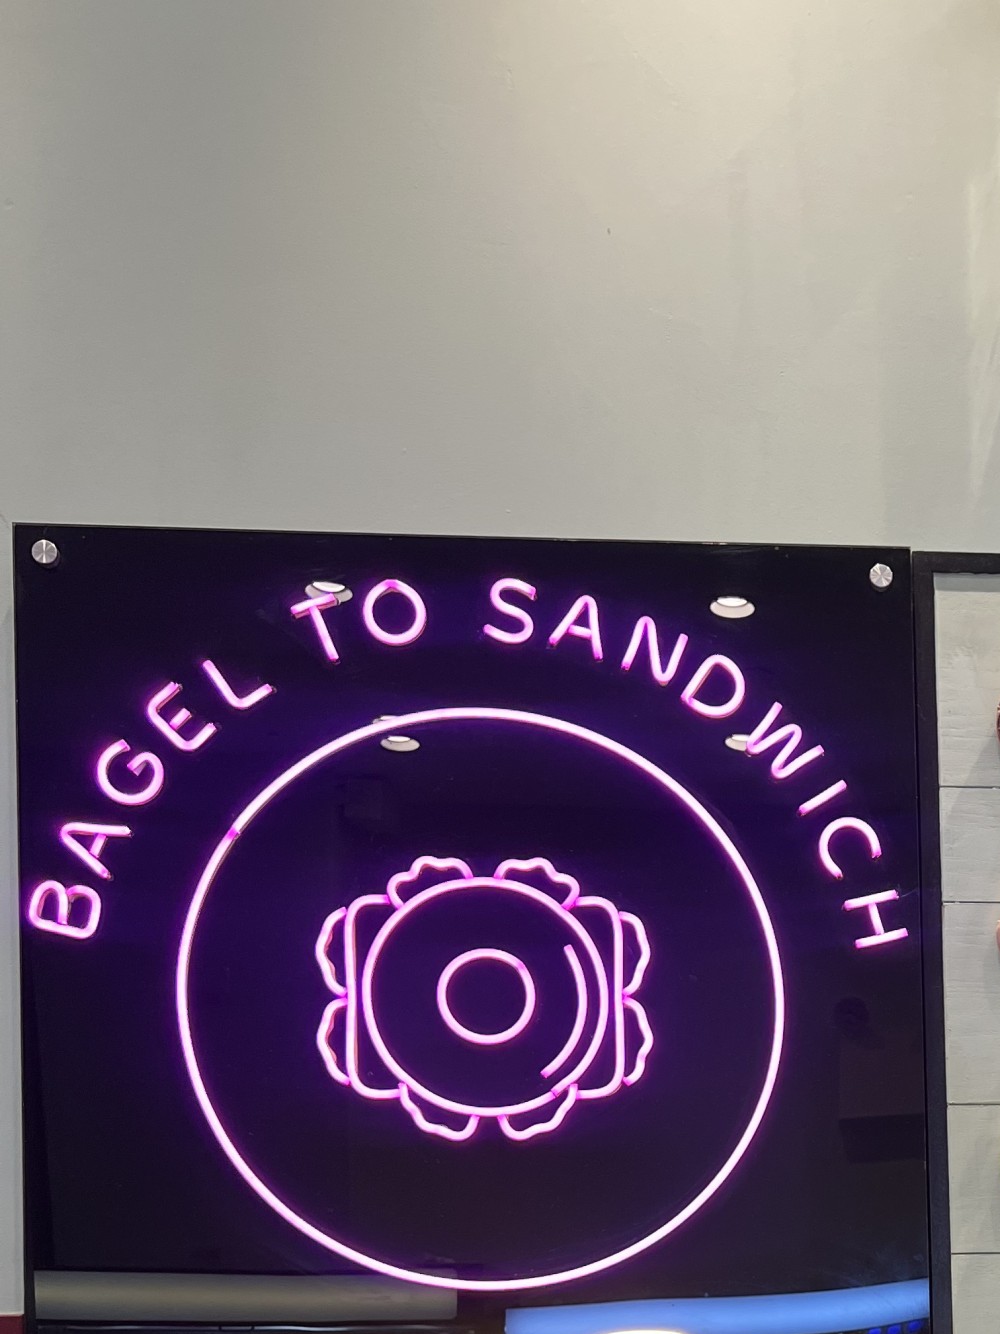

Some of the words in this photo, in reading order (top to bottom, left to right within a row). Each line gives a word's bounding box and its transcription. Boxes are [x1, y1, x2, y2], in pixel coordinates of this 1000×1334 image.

[27, 658, 276, 941] BAGEL
[289, 576, 428, 664] TO
[482, 576, 910, 949] SANDWICH
